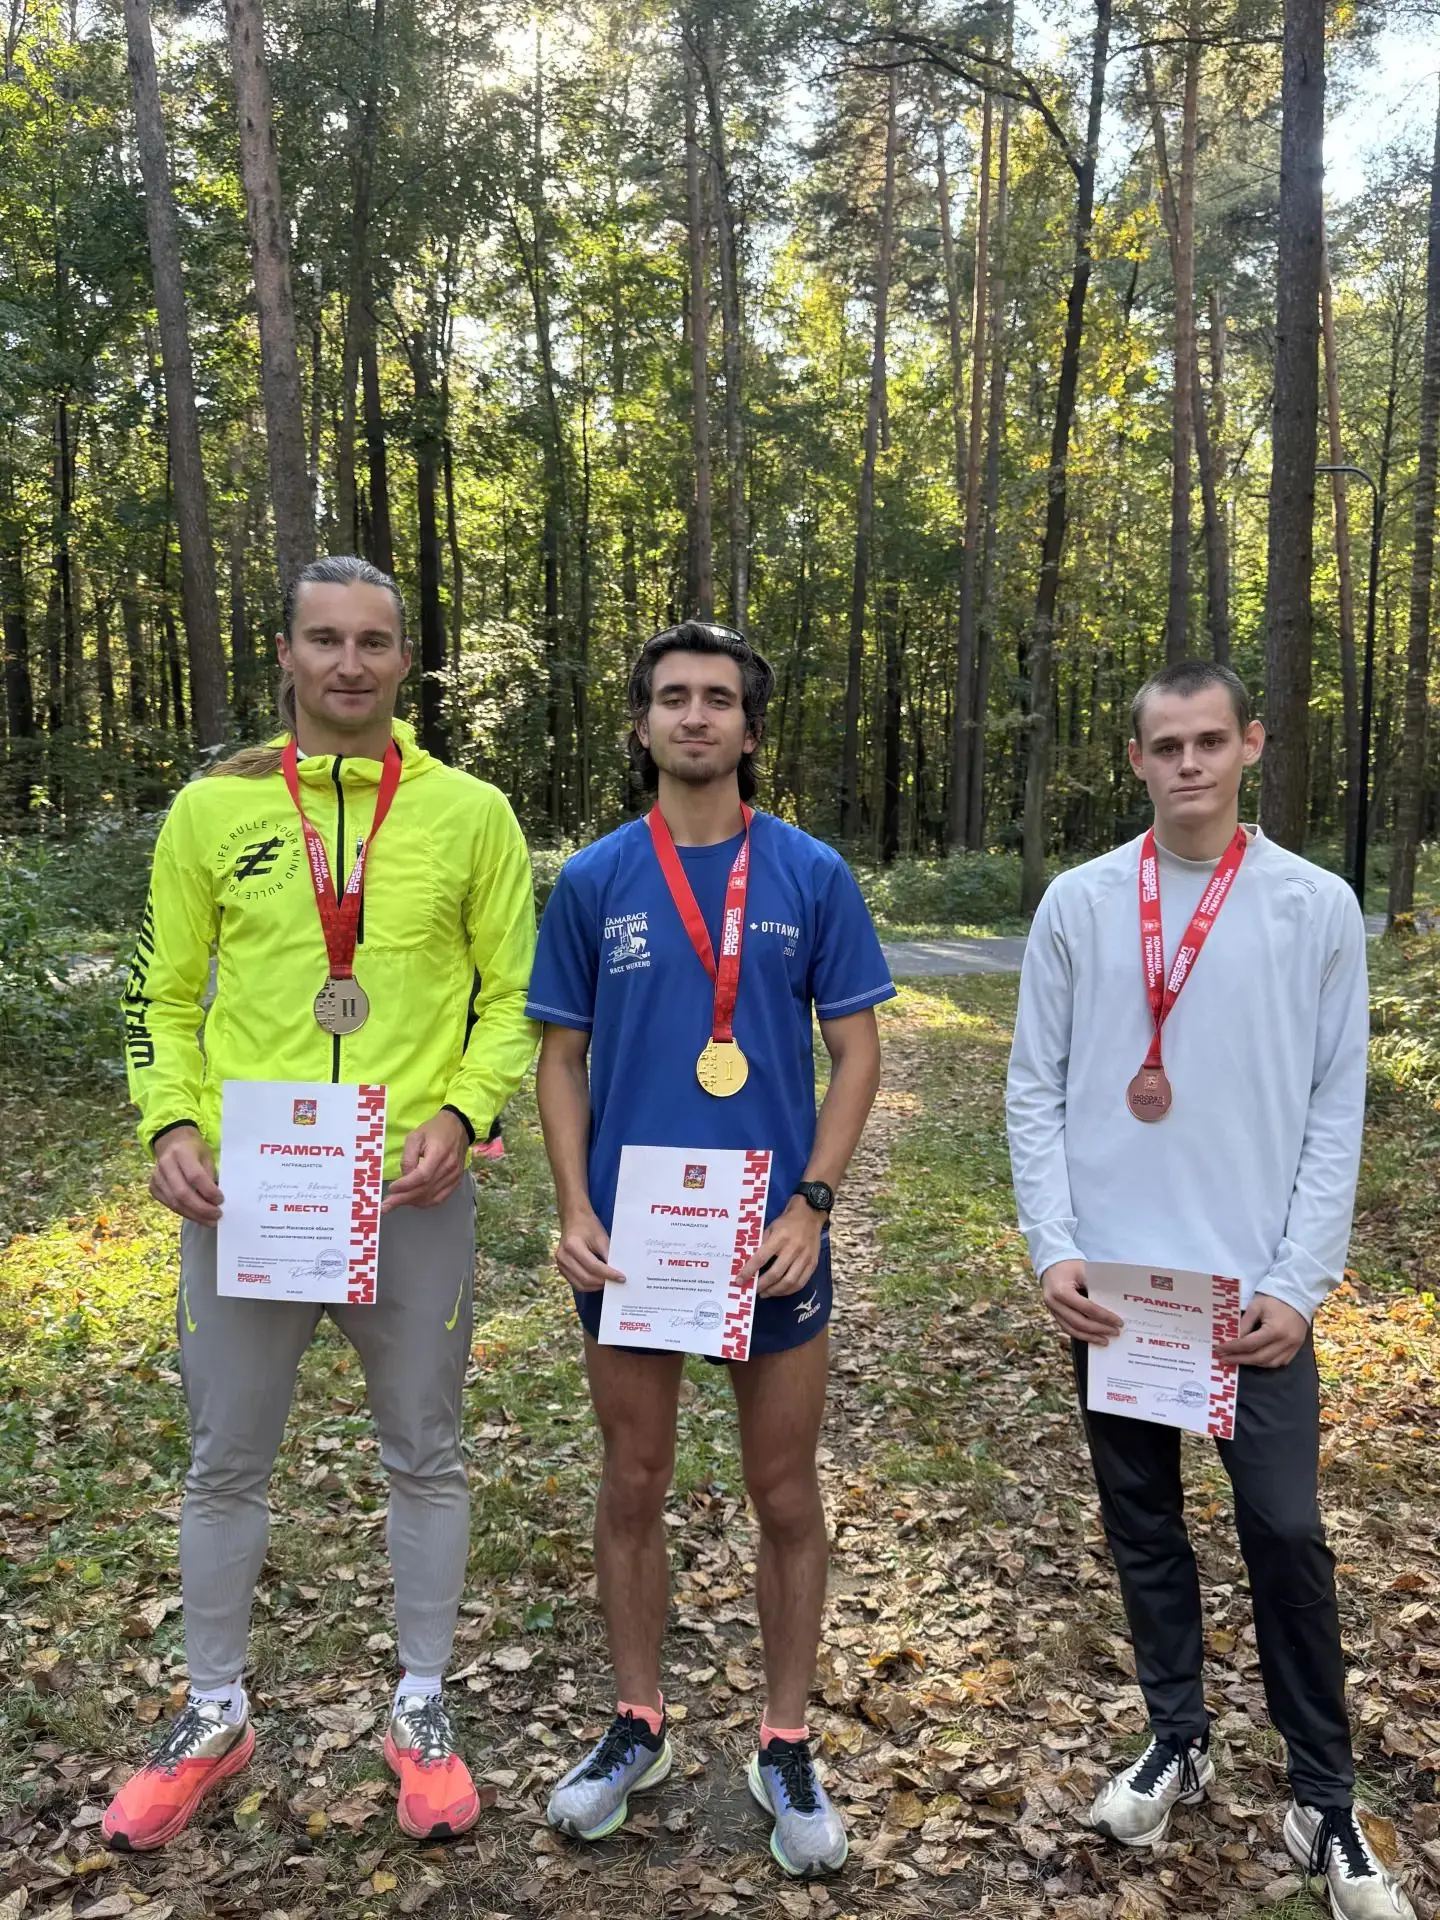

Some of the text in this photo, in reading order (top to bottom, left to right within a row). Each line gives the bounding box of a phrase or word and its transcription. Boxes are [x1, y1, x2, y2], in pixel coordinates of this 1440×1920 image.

[229, 821, 268, 840] RULLE
[273, 824, 298, 844] YOUR
[217, 844, 230, 870] LIFE
[286, 850, 300, 880] MIND
[308, 838, 324, 894] ГУБЕРНАТОРА
[315, 838, 330, 879] КОМАНДА
[245, 882, 284, 900] RULLE
[1148, 857, 1158, 900] МОСОБЛ
[1200, 877, 1222, 913] КОМАНДА
[1207, 868, 1234, 916] ГУБЕРНАТОРА
[723, 909, 734, 956] МОСОБЛ
[762, 921, 800, 940] OTTAWA
[1145, 936, 1156, 988] ГУБЕРНАТОРА
[1154, 936, 1162, 974] КОМАНДА
[610, 966, 625, 974] RACE
[1168, 946, 1189, 992] МОСОБЛ
[1173, 956, 1192, 993] СПОРТ
[260, 1144, 345, 1156] ГРАМОТА
[284, 1204, 328, 1212] МЕСТО
[651, 1204, 729, 1218] ГРАМОТА
[668, 1259, 709, 1268] МЕСТО
[1124, 1294, 1204, 1313] ГРАМОТА
[1148, 1338, 1190, 1350] МЕСТО
